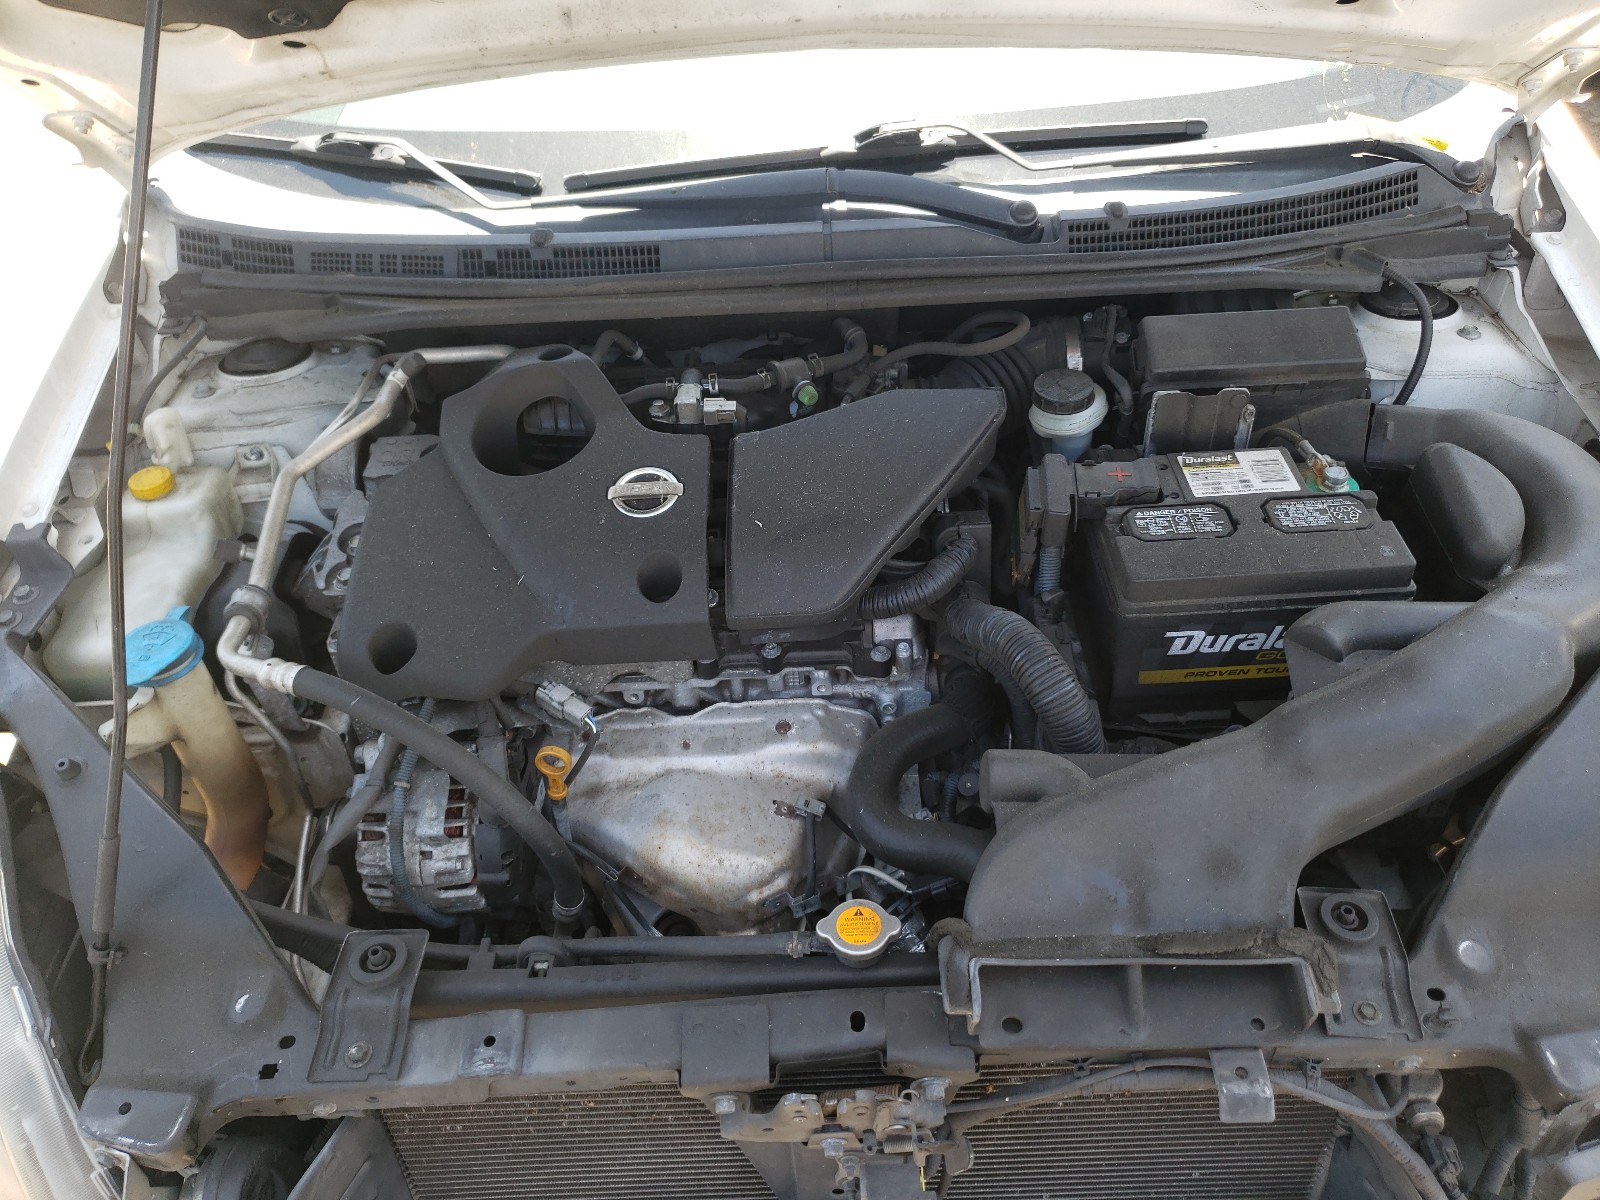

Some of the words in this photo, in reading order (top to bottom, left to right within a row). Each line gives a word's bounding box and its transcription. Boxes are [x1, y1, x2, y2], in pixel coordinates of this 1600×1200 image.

[1182, 454, 1233, 464] Duralast
[1183, 668, 1251, 679] PROVEN
[1255, 667, 1289, 676] TOU
